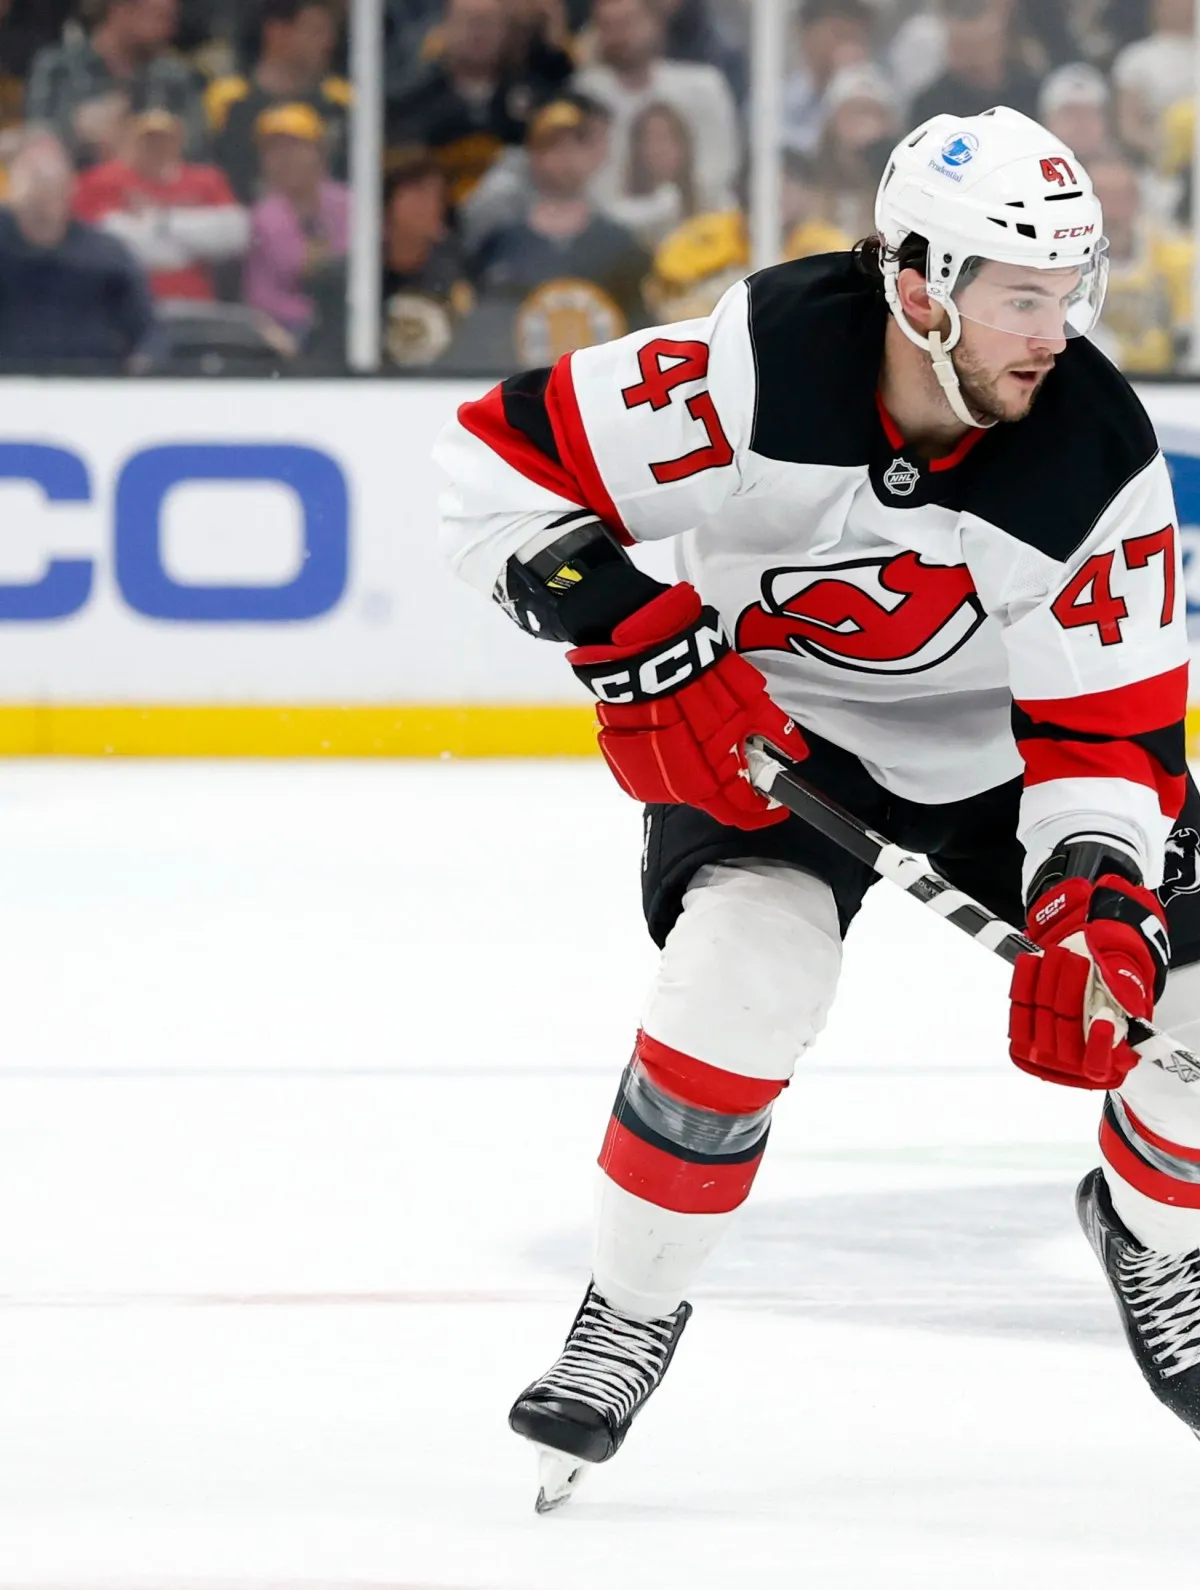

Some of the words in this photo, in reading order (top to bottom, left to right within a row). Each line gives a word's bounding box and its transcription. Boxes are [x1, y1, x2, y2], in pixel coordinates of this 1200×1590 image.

[928, 159, 963, 183] Prudential
[1039, 157, 1077, 187] 47
[1053, 223, 1095, 240] CCM
[621, 338, 734, 484] 47
[889, 473, 912, 483] NHL
[1050, 523, 1177, 646] 47
[591, 625, 729, 704] CCM
[1035, 893, 1066, 922] CCM
